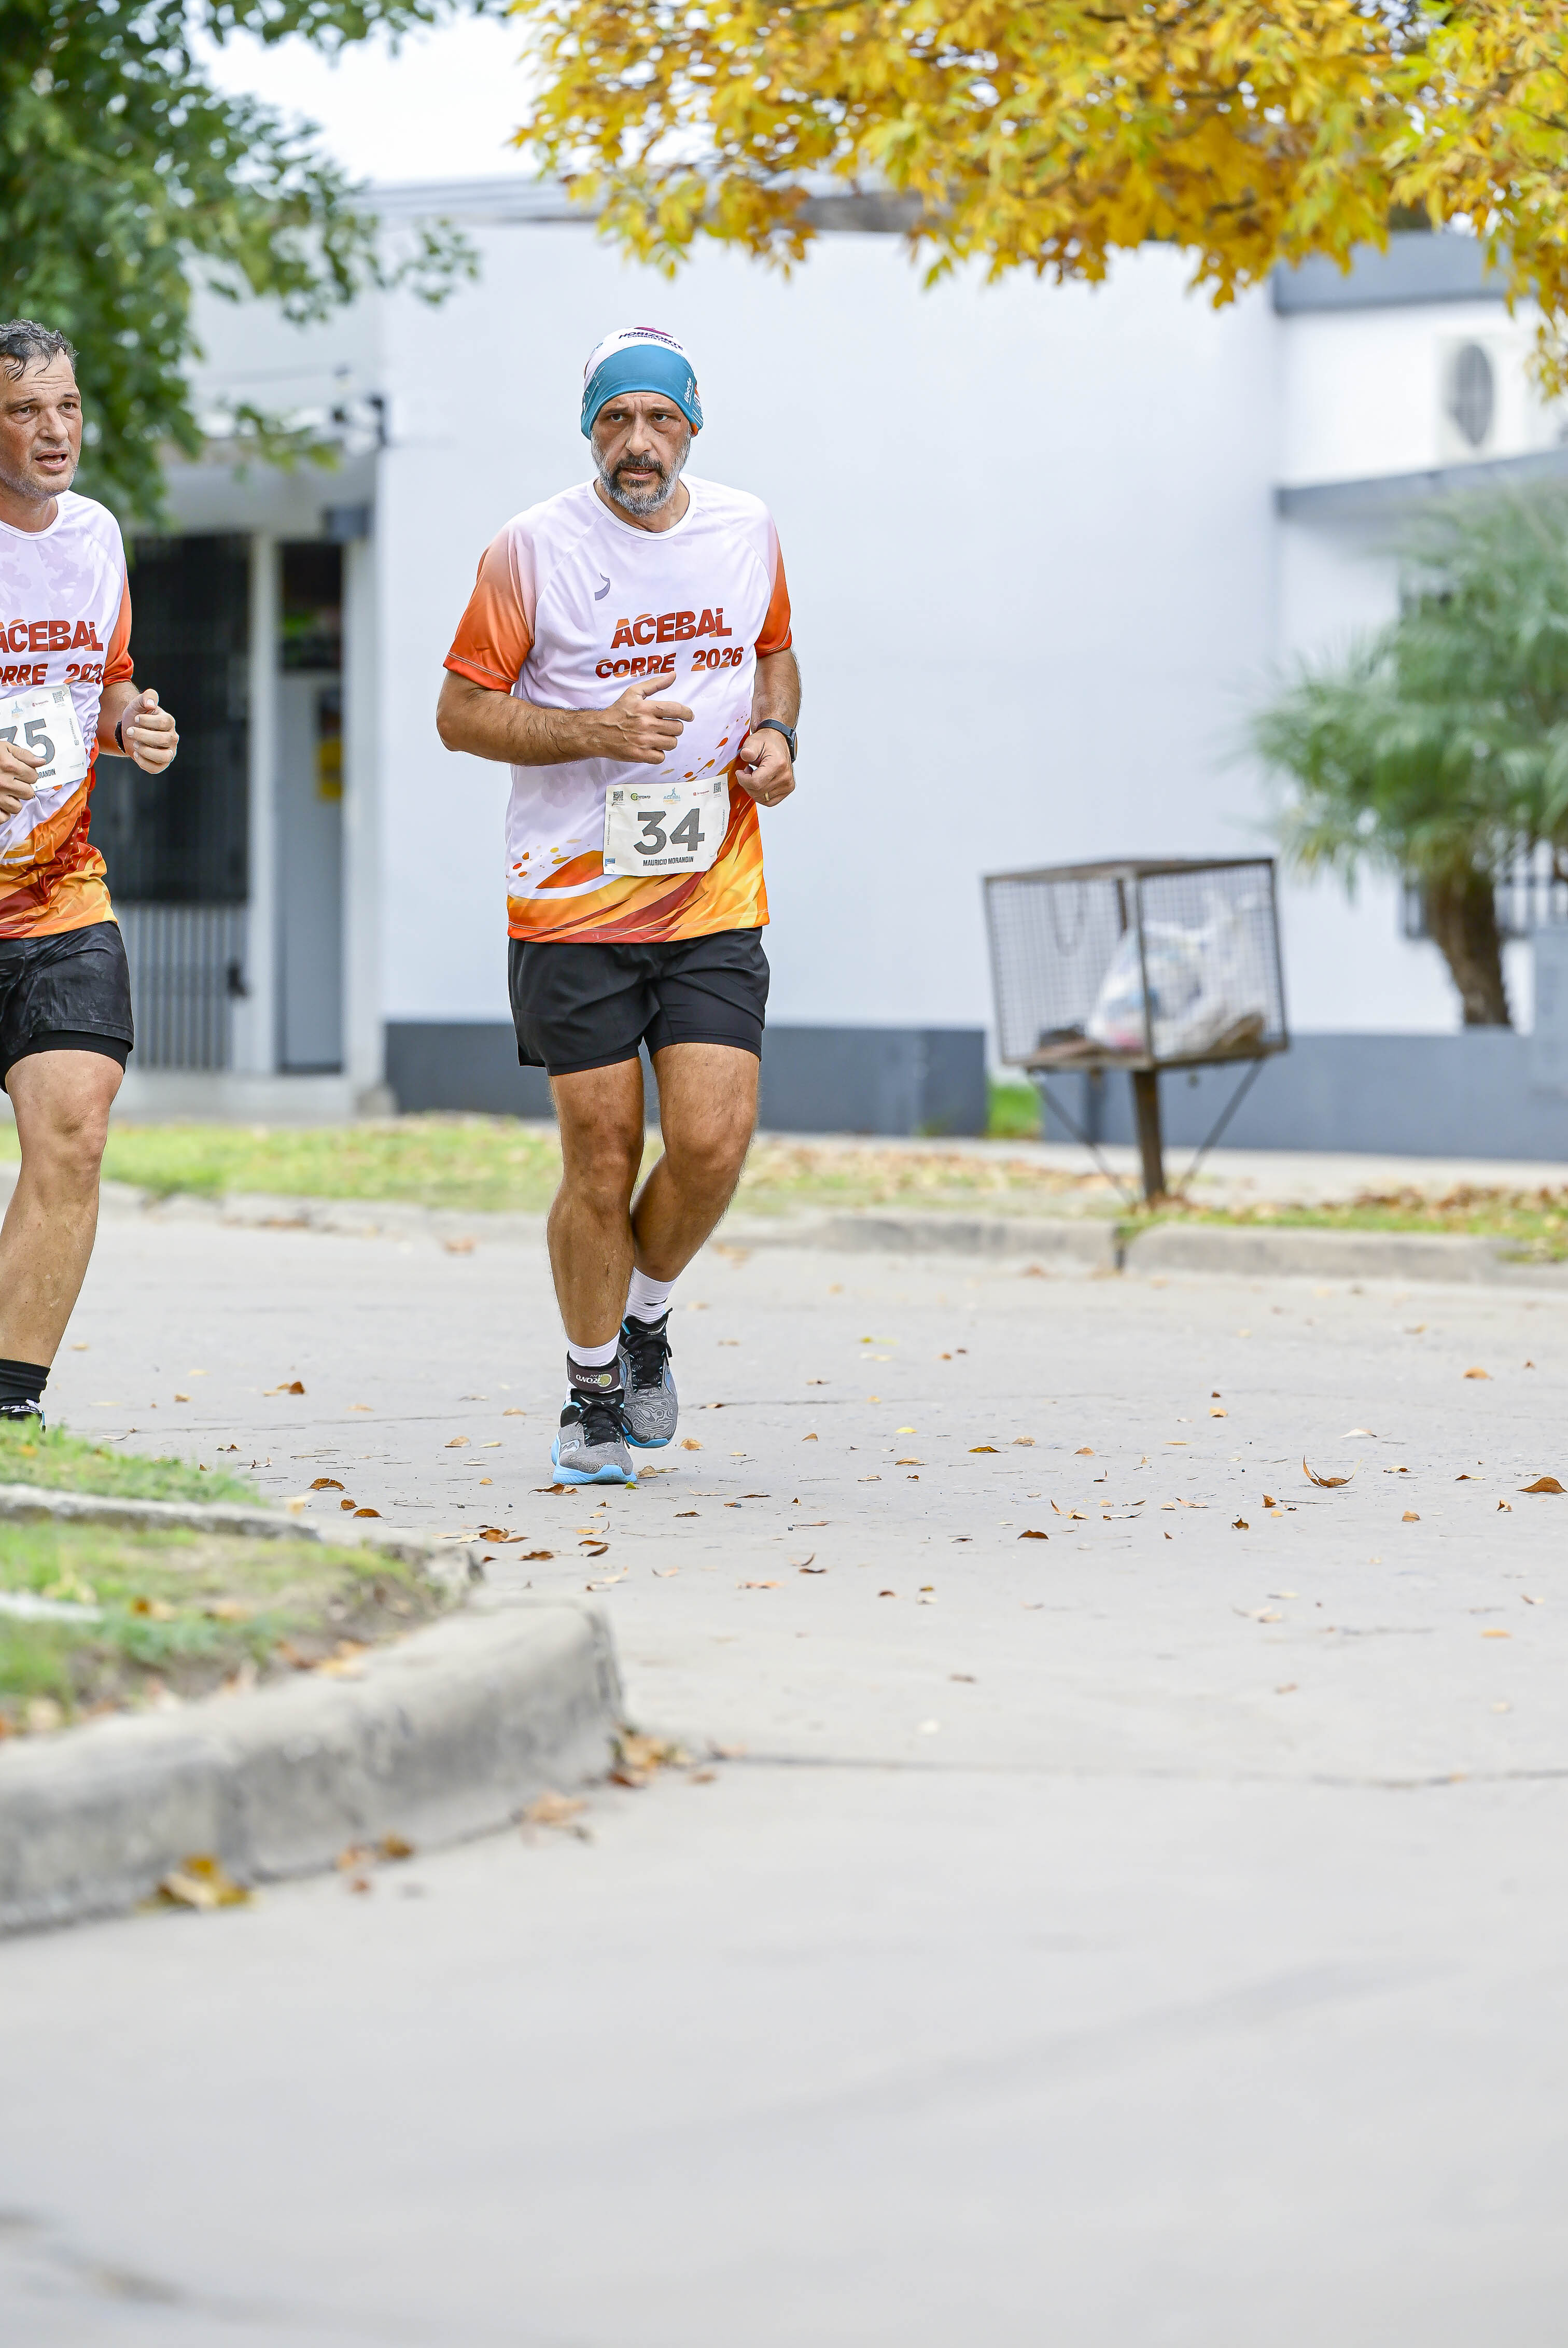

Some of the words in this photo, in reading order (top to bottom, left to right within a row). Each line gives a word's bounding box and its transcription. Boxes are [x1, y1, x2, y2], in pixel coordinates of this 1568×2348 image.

[619, 331, 683, 351] HORIZONTE
[610, 608, 732, 649] ACEBAL
[595, 652, 677, 678] CORRE
[691, 647, 744, 672] 2026
[633, 808, 705, 855] 34
